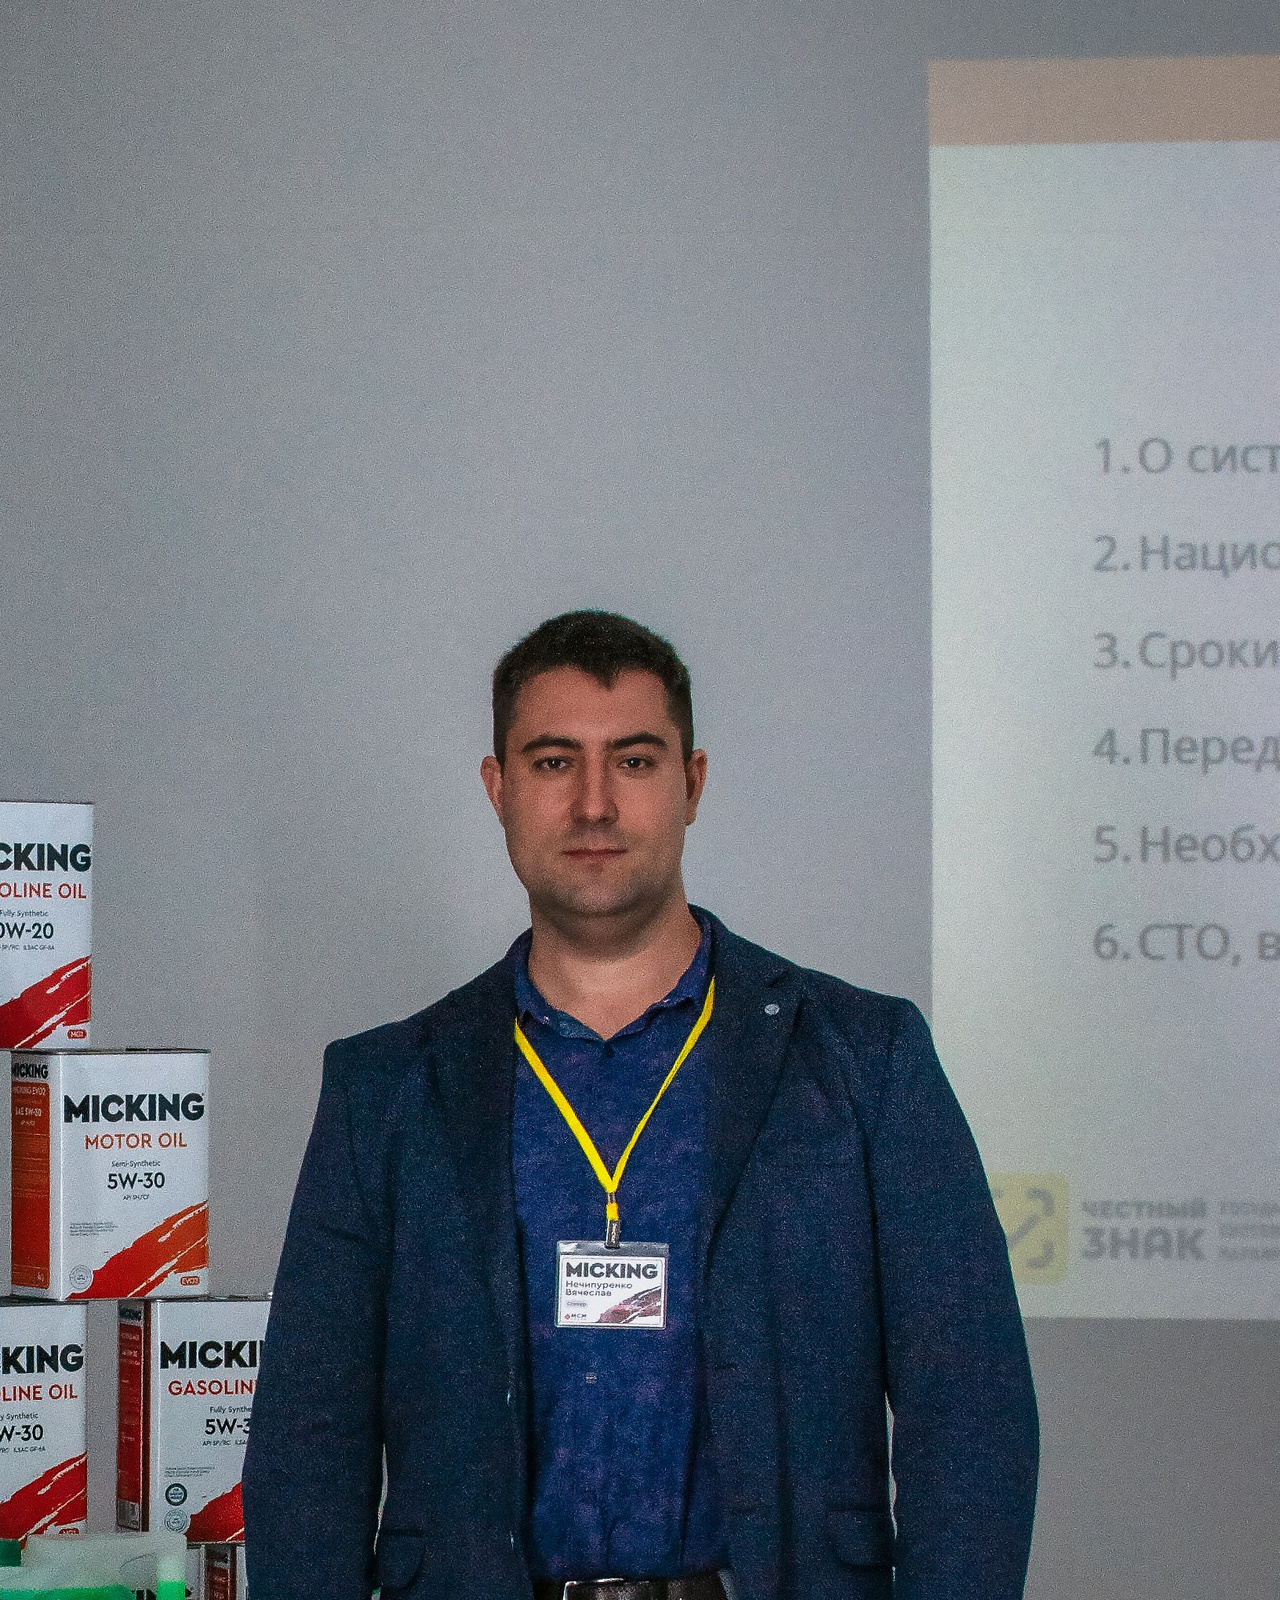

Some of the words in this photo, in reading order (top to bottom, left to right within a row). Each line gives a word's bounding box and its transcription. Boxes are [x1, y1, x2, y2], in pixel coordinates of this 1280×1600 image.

[58, 882, 87, 899] OIL
[0, 909, 15, 918] Fully
[17, 909, 48, 918] Synthetic
[63, 1093, 205, 1123] MICKING
[85, 1133, 152, 1150] MOTOR
[158, 1132, 187, 1148] OIL
[111, 1159, 161, 1168] Semi-Synthetic
[107, 1172, 165, 1189] 5W-30
[1083, 1227, 1206, 1260] ЗНАК
[566, 1262, 658, 1279] MICKING
[566, 1281, 632, 1289] Нечипуренко
[49, 1384, 78, 1400] OIL
[168, 1380, 257, 1395] GASOLIN
[6, 1412, 39, 1420] Synthetic
[210, 1406, 226, 1414] Fully
